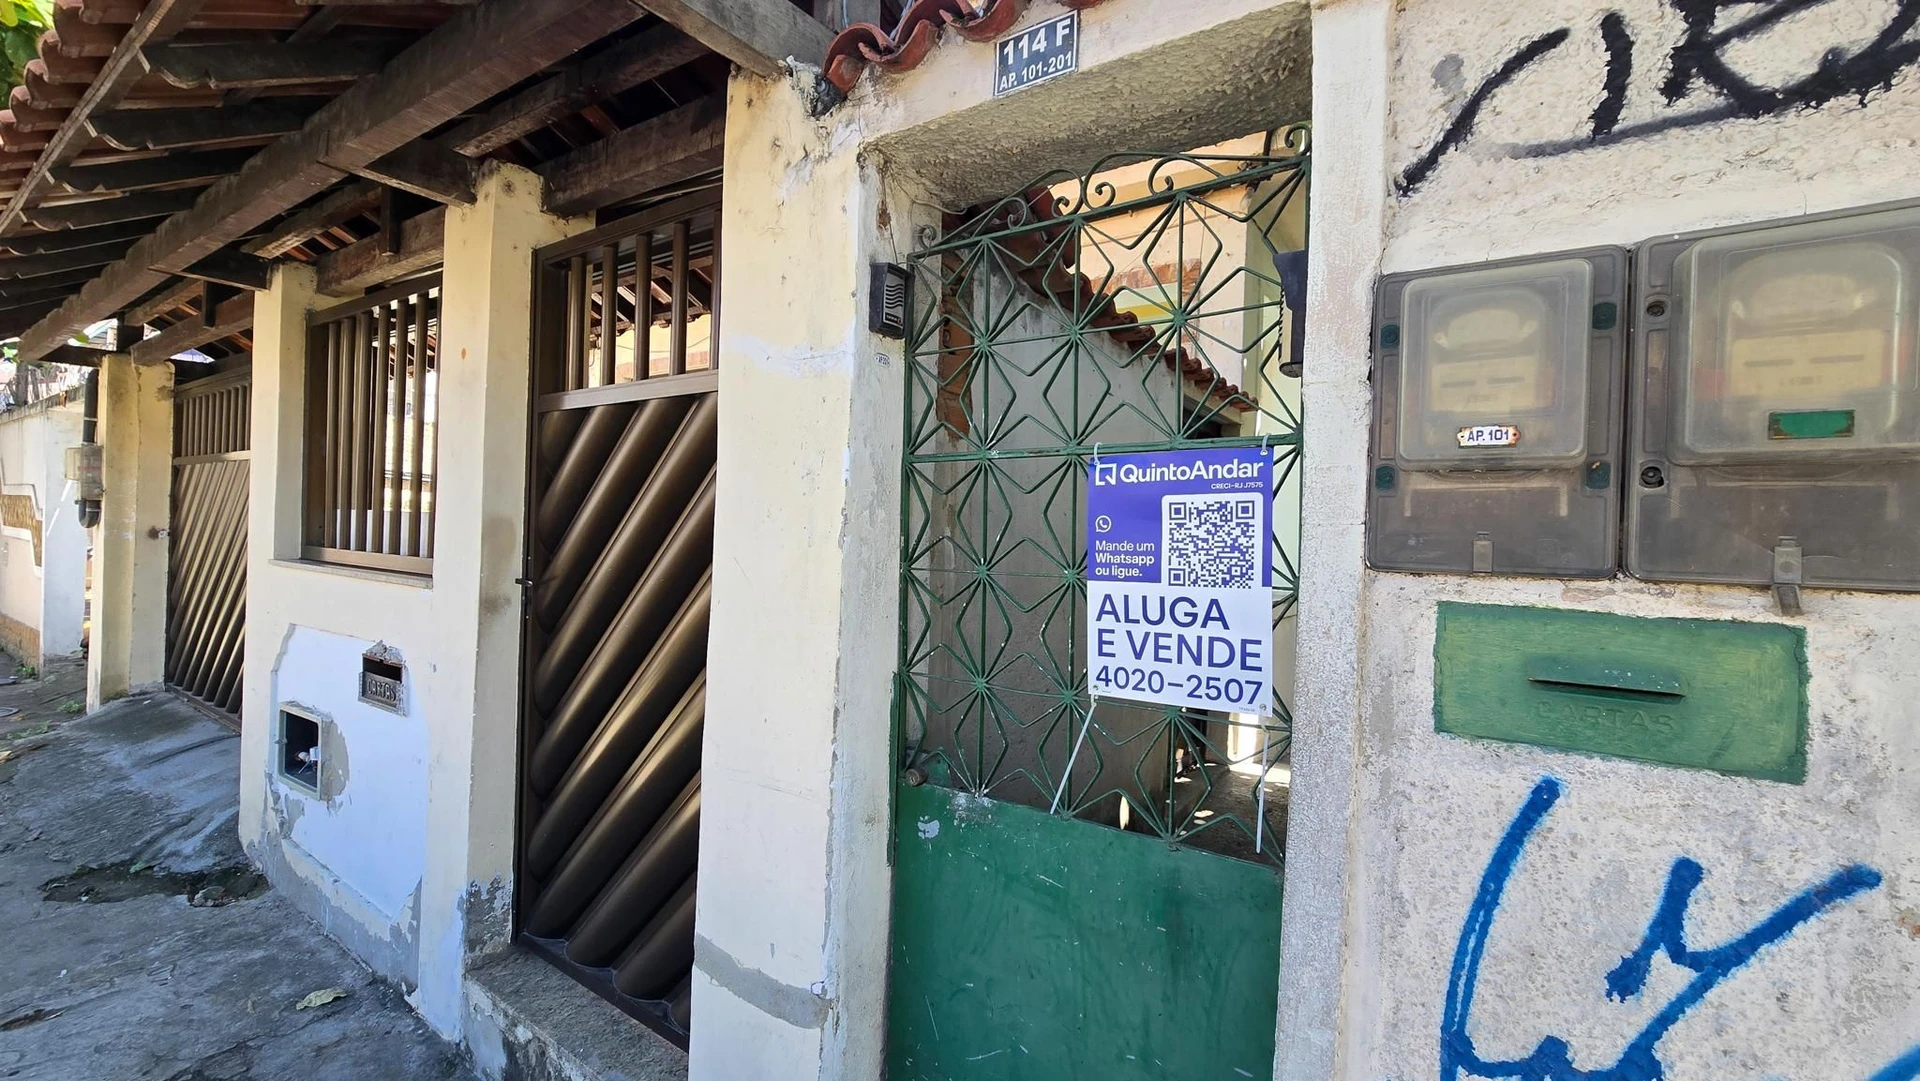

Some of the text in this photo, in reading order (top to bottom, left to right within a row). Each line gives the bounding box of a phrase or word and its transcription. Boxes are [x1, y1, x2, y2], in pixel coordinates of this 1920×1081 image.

[1003, 17, 1071, 65] 114 F
[999, 51, 1072, 91] AP. 101-201
[1119, 459, 1263, 484] QuintoAndar
[1095, 540, 1155, 552] Mande um
[1095, 553, 1155, 567] Whatsapp
[1095, 566, 1143, 578] ou ligue.
[1095, 593, 1230, 630] ALUGA
[1097, 628, 1263, 672] E VENDE
[367, 679, 397, 702] CARTAS
[1095, 665, 1263, 705] 4020-2507
[1535, 700, 1675, 736] CARTAS
